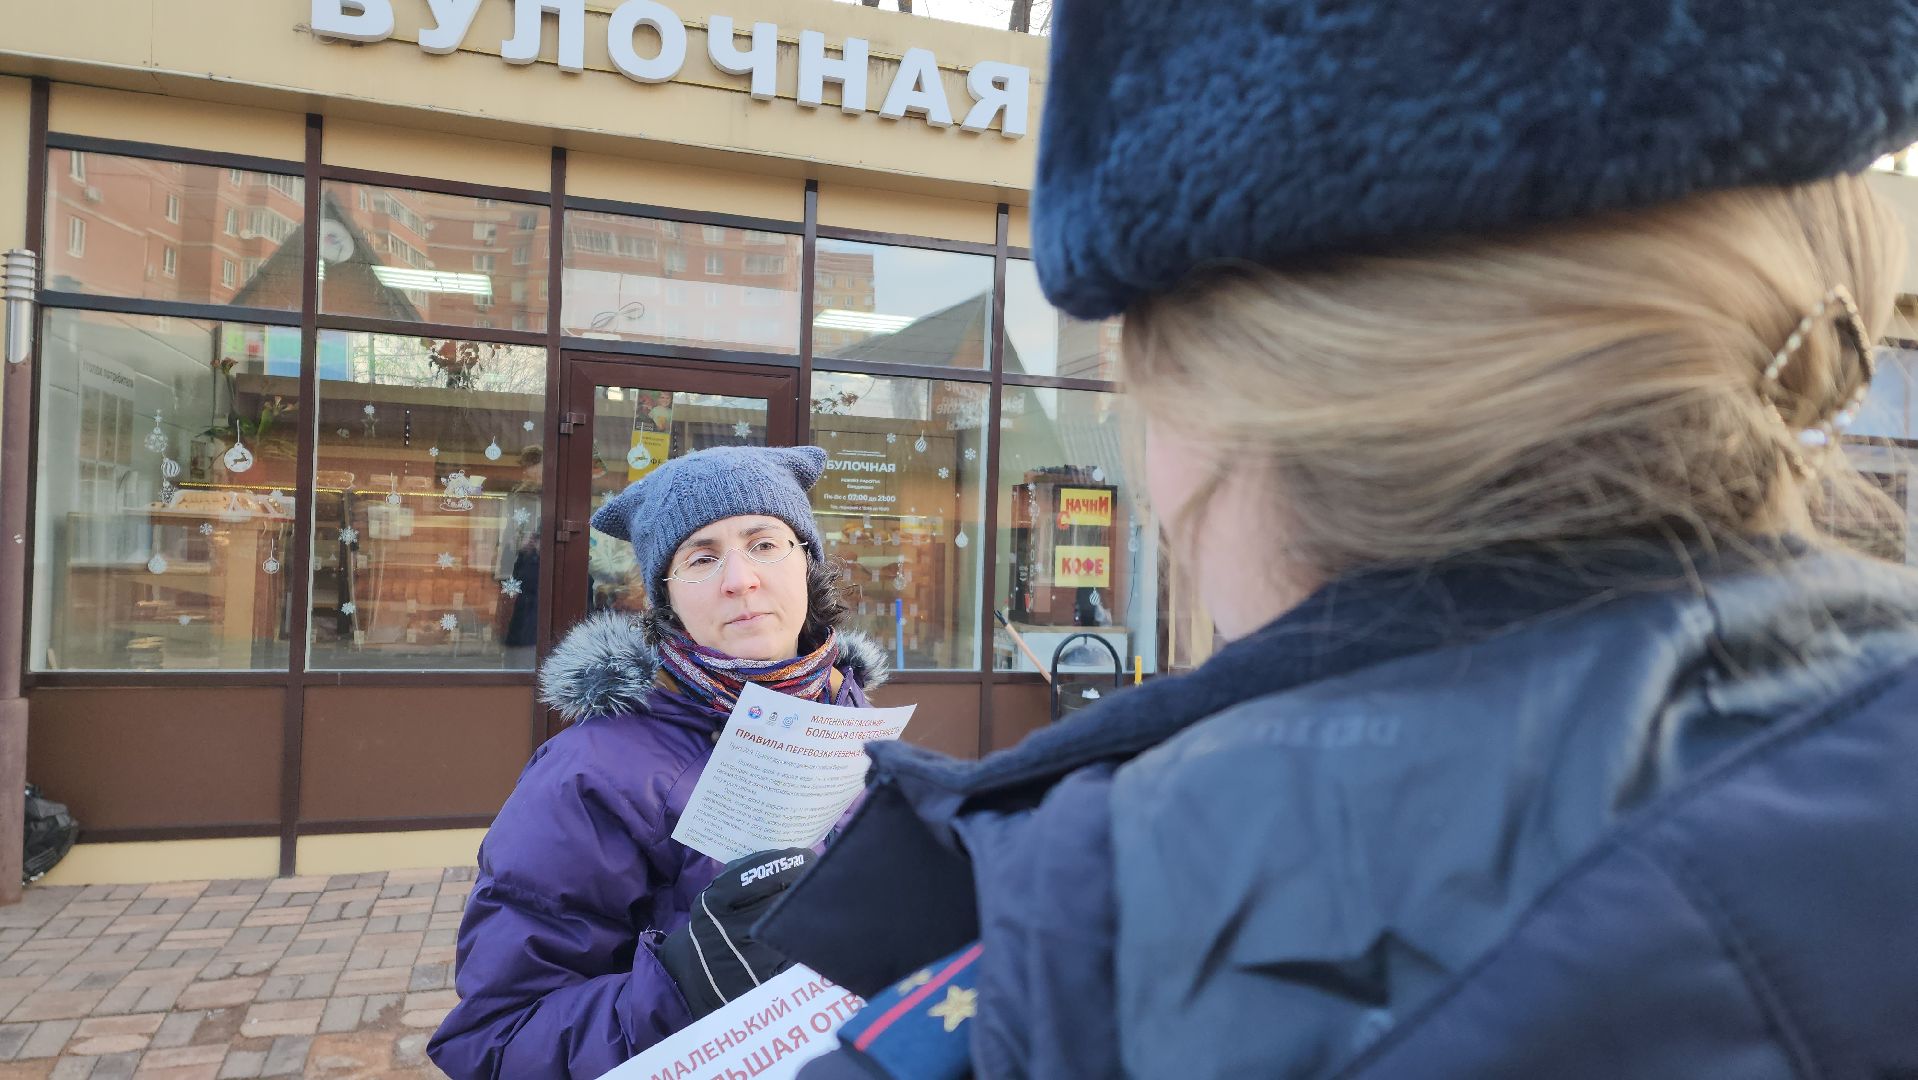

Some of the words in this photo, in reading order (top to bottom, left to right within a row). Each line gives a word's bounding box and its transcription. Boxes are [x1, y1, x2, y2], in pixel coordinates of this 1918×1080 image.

[826, 460, 896, 472] БУЛОЧНАЯ
[1066, 496, 1109, 513] НАЧНИ
[1056, 511, 1070, 530] С
[1061, 557, 1105, 576] КОФЕ
[735, 728, 784, 751] ПРАВИЛА
[785, 743, 833, 758] ПЕРЕВОЗКИ
[805, 727, 848, 740] БОЛЬШАЯ
[810, 990, 864, 1034] ОТВ
[651, 996, 792, 1080] МАЛЕНЬКИЙ
[791, 976, 834, 1007] ПАС
